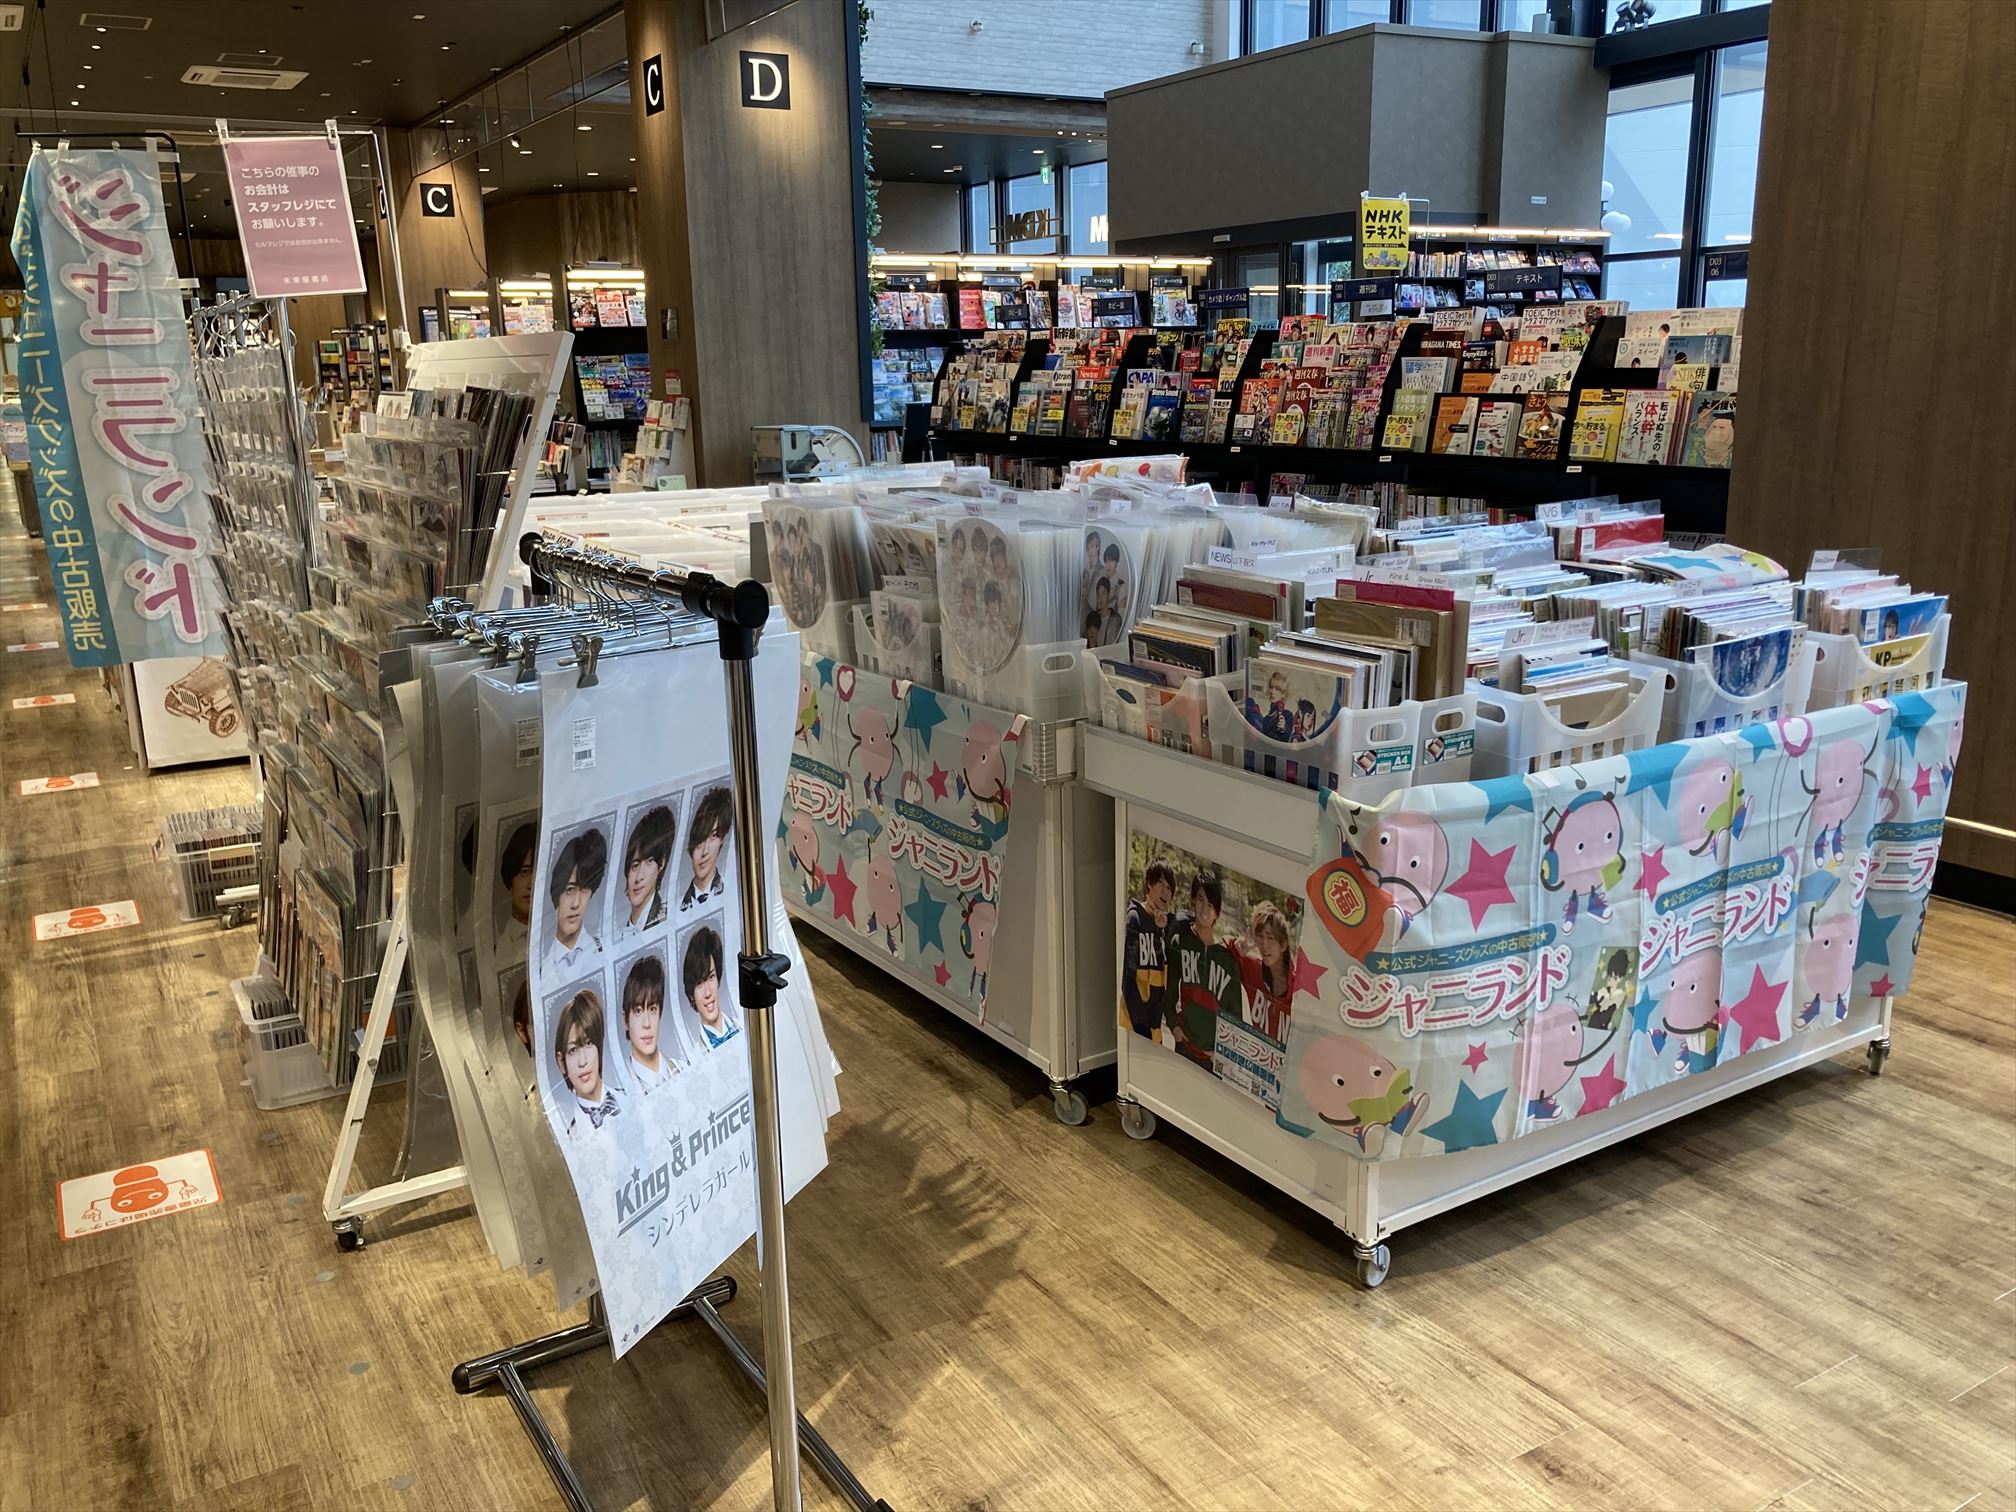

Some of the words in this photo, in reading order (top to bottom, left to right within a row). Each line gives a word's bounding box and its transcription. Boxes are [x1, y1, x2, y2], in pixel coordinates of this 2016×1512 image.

[647, 64, 661, 107] C
[747, 57, 784, 102] D
[241, 165, 320, 179] こちらの催事の
[244, 183, 290, 196] お会計は
[247, 198, 337, 213] スタッフレジにて
[427, 186, 449, 213] C
[251, 216, 324, 230] お願いします。
[1365, 209, 1403, 223] NHK
[1365, 225, 1407, 240] テキスト
[1709, 257, 1722, 267] D03
[1515, 273, 1543, 284] テキスト
[1711, 268, 1720, 277] 06
[1524, 309, 1545, 317] TOEIC
[1546, 308, 1560, 316] Test
[1305, 346, 1335, 359] 週刊新潮
[1293, 368, 1319, 380] 週刊文春
[1693, 366, 1706, 389] 俳句
[1285, 390, 1308, 401] 週刊文春
[55, 173, 201, 636] ジャニランド
[1632, 401, 1645, 436] バランス
[1641, 401, 1659, 436] 体幹
[1652, 401, 1669, 452] 転ばぬ先の
[1542, 506, 1558, 518] V6
[1210, 551, 1232, 564] NEWS
[1875, 651, 1892, 666] KP
[1459, 740, 1471, 750] A4
[1377, 751, 1400, 759] STOCKER
[1393, 755, 1408, 766] A4
[888, 816, 1001, 896] ジャニランド
[1640, 880, 1791, 973] ジャニランド
[1208, 959, 1232, 1001] NY
[1344, 949, 1568, 1033] ジャニランド
[615, 1163, 671, 1225] King
[671, 1142, 688, 1178] &
[688, 1103, 751, 1167] Prince
[648, 1150, 750, 1249] シンデレラガール
